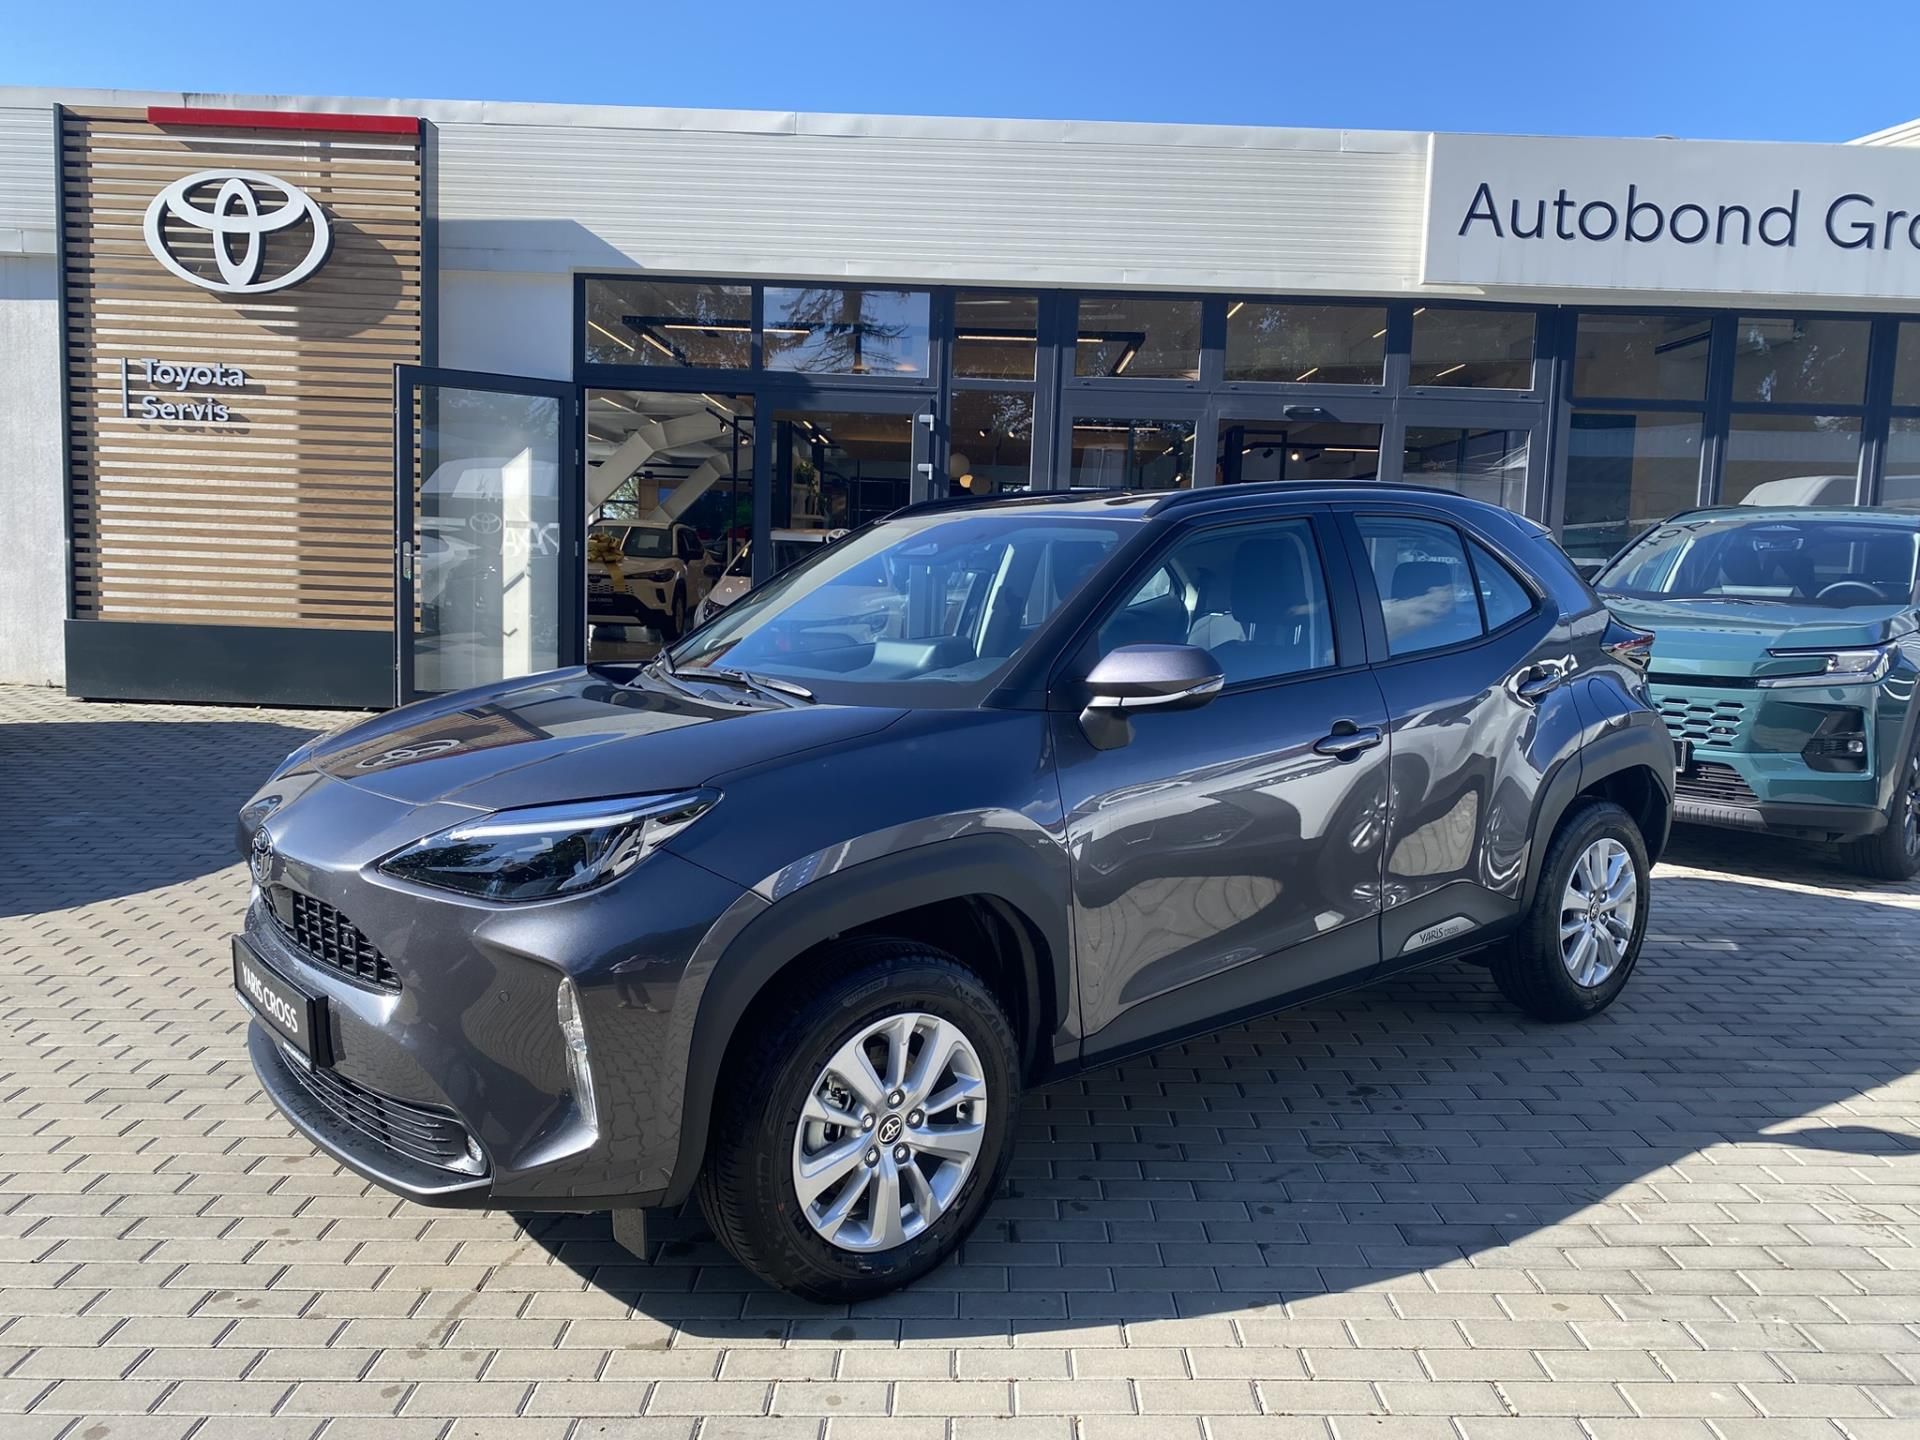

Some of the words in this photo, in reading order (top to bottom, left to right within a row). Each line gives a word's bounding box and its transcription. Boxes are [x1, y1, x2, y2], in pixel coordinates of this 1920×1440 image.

[1458, 182, 1801, 248] Autobond
[141, 358, 246, 391] Toyota
[142, 395, 230, 422] Servis
[242, 961, 264, 1004] YARIS
[263, 986, 298, 1033] CROSS
